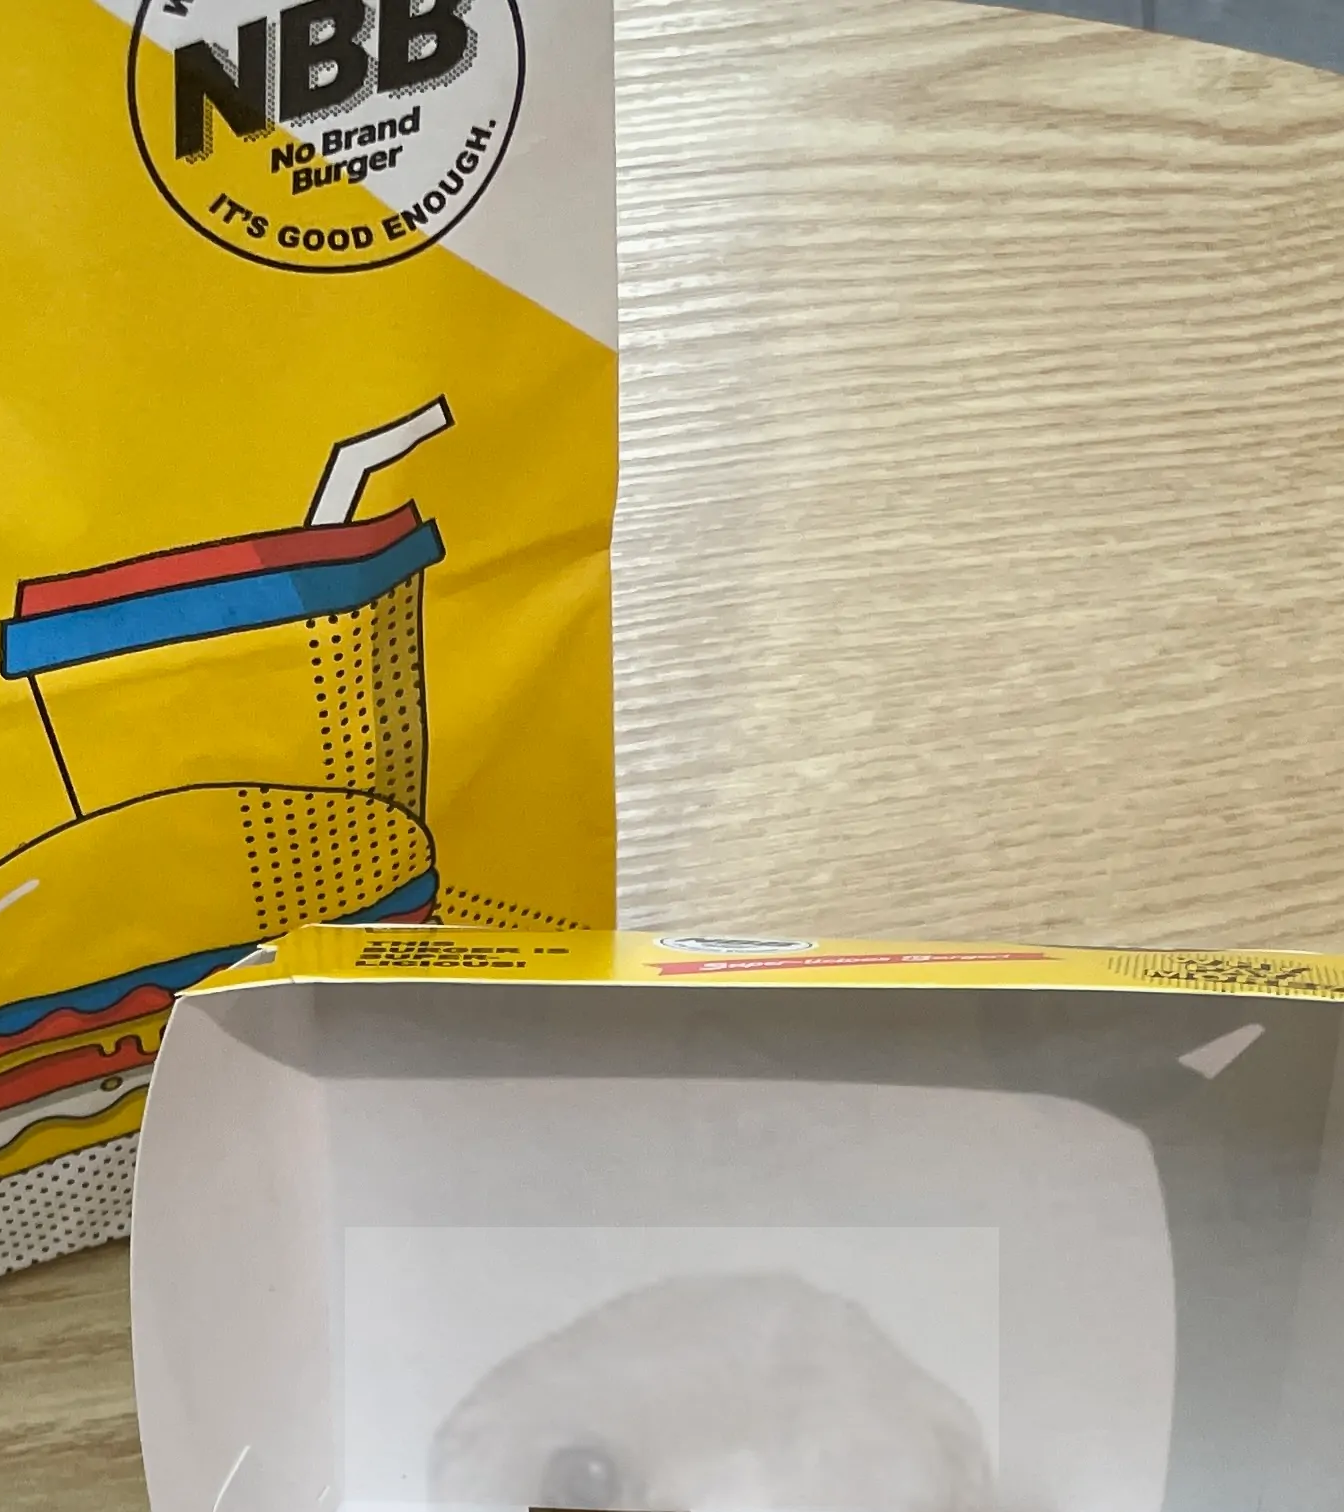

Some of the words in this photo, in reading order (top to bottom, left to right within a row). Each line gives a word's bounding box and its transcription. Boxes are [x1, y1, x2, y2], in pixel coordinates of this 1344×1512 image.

[173, 0, 477, 164] NBB
[208, 192, 270, 240] IT'S
[277, 223, 375, 252] GOOD
[381, 119, 497, 241] ENOUGH.
[271, 140, 316, 173] No
[321, 105, 421, 156] Brand
[292, 145, 404, 196] Burger
